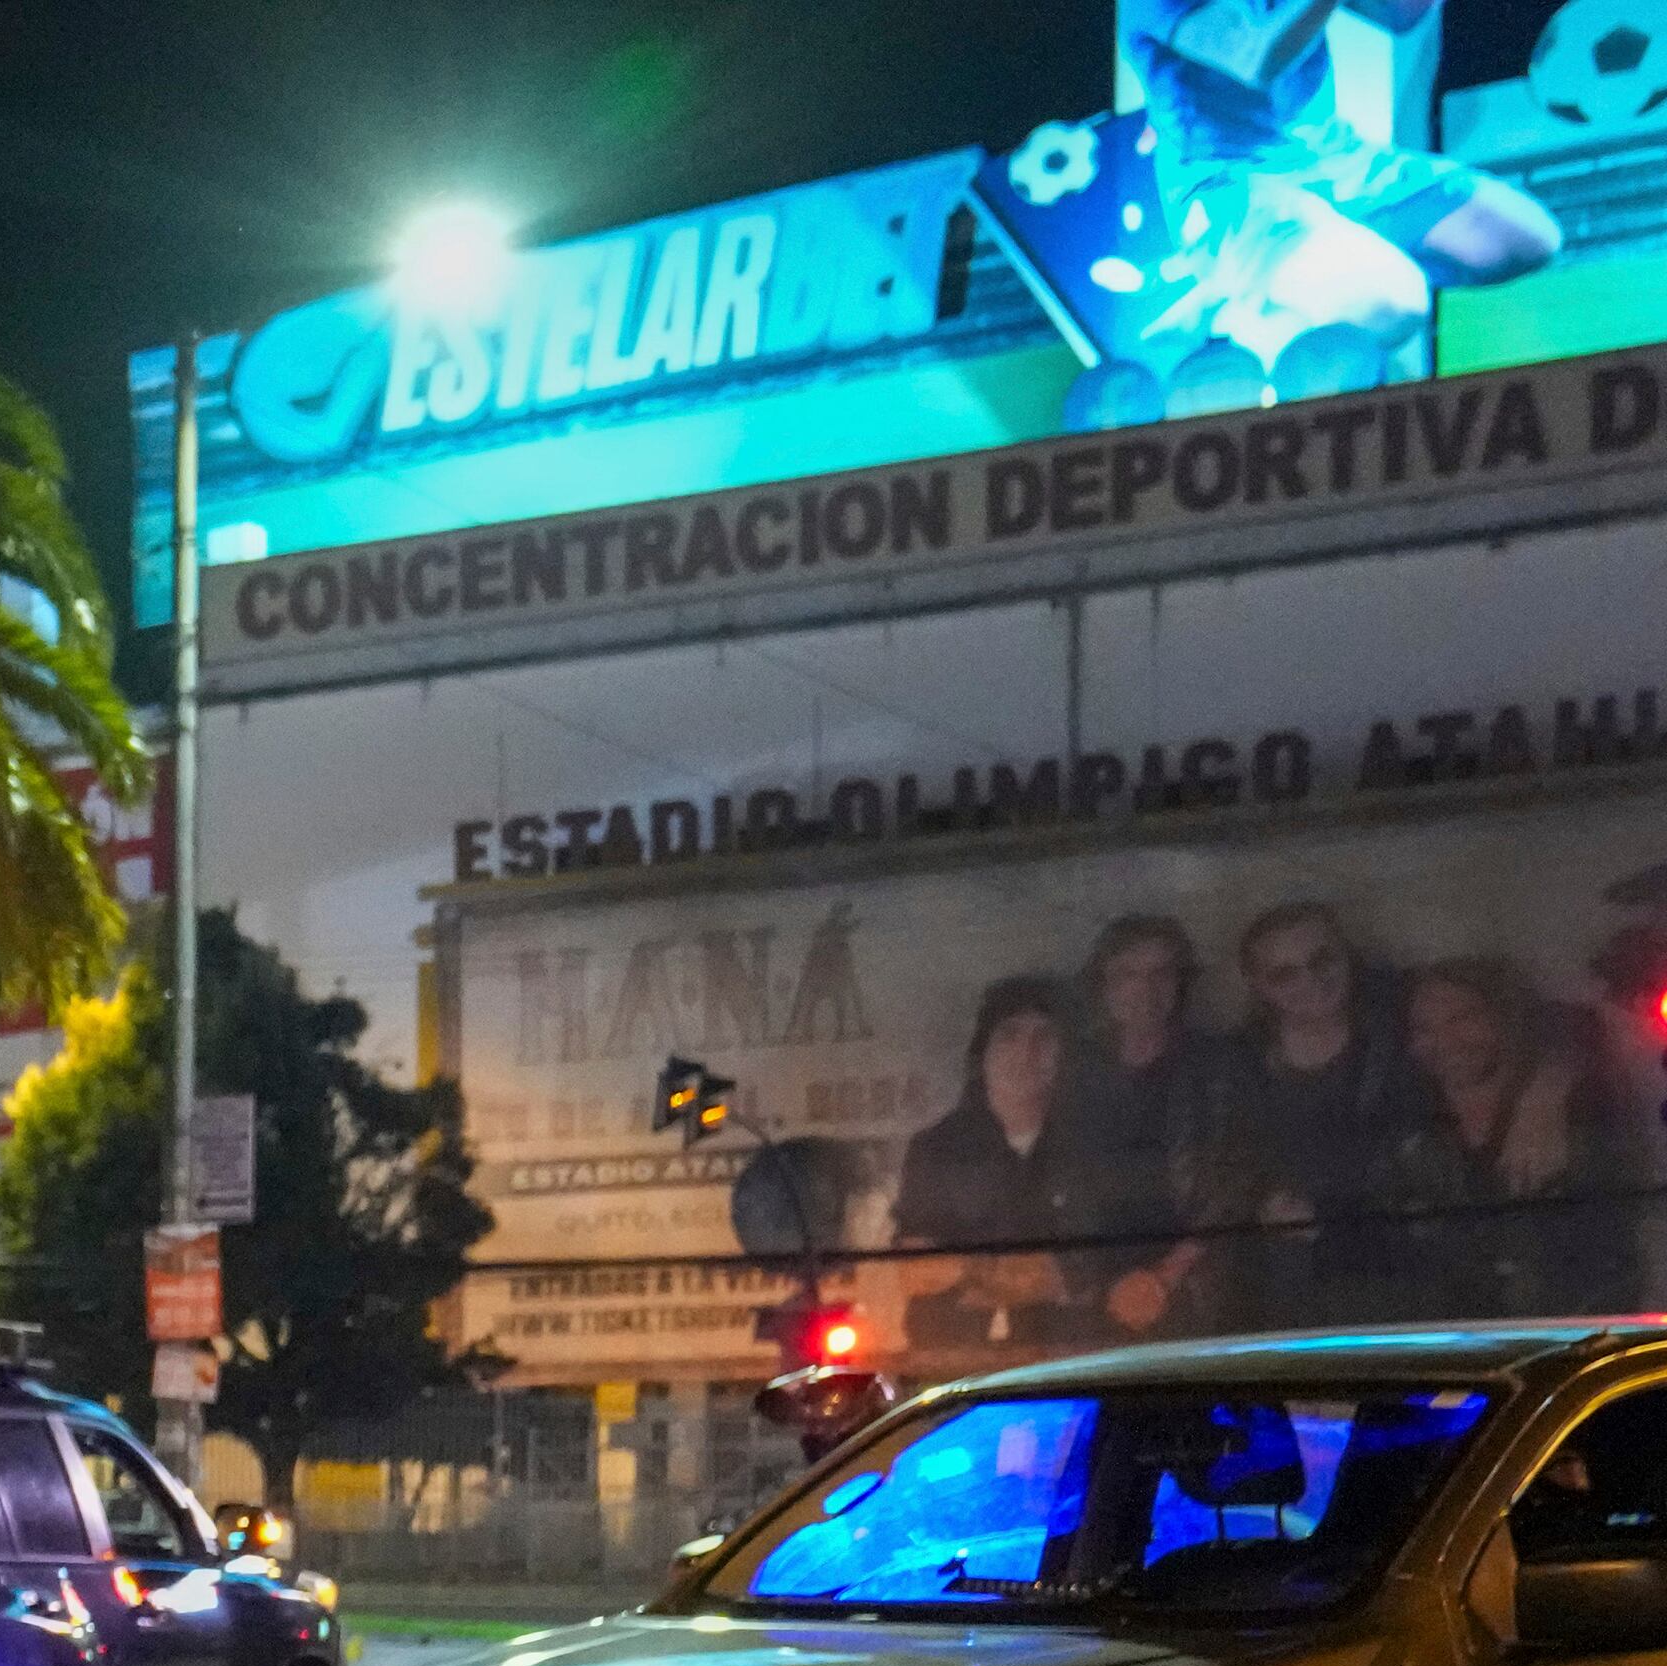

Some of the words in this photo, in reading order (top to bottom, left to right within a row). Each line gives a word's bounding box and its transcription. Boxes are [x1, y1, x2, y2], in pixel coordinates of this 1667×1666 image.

[233, 470, 951, 640] CONCENTRACION
[984, 380, 1549, 542] DEPORTIVA
[510, 1158, 655, 1191] ESTADIO
